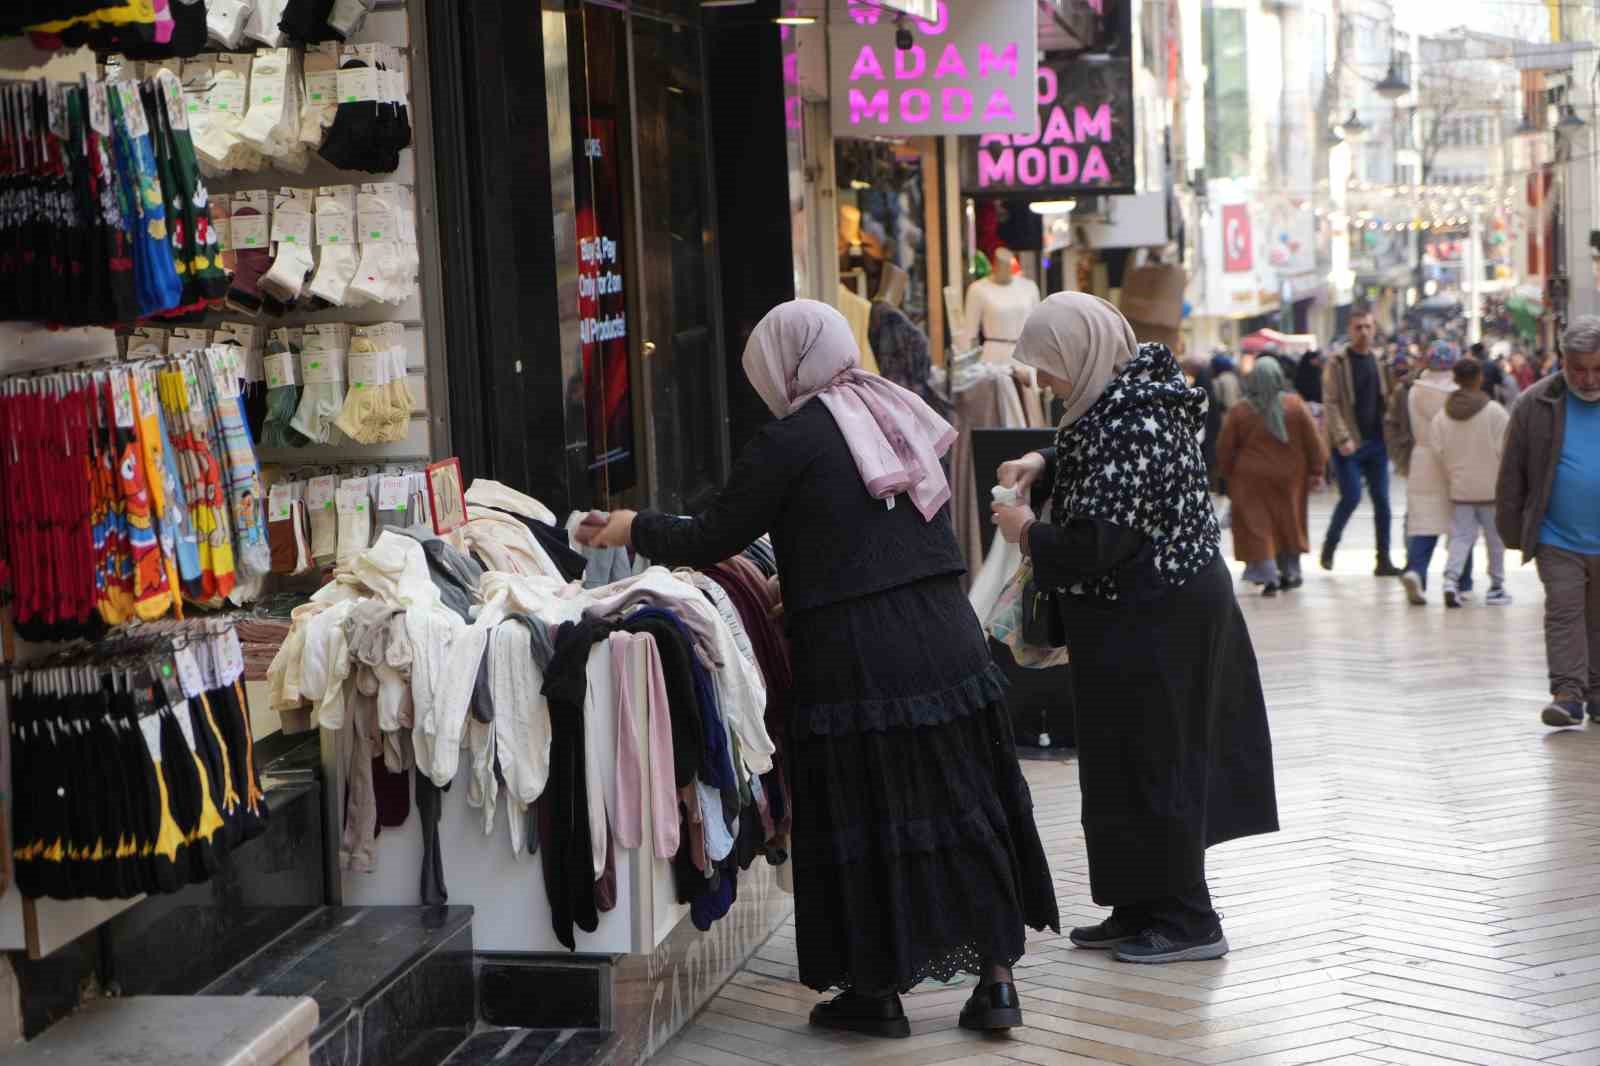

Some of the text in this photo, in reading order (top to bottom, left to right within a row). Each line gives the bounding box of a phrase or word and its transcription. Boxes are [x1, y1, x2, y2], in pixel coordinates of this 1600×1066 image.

[849, 42, 1018, 81] ADAM
[848, 87, 1017, 125] MODA
[978, 146, 1112, 188] MODA
[602, 236, 616, 263] Pay
